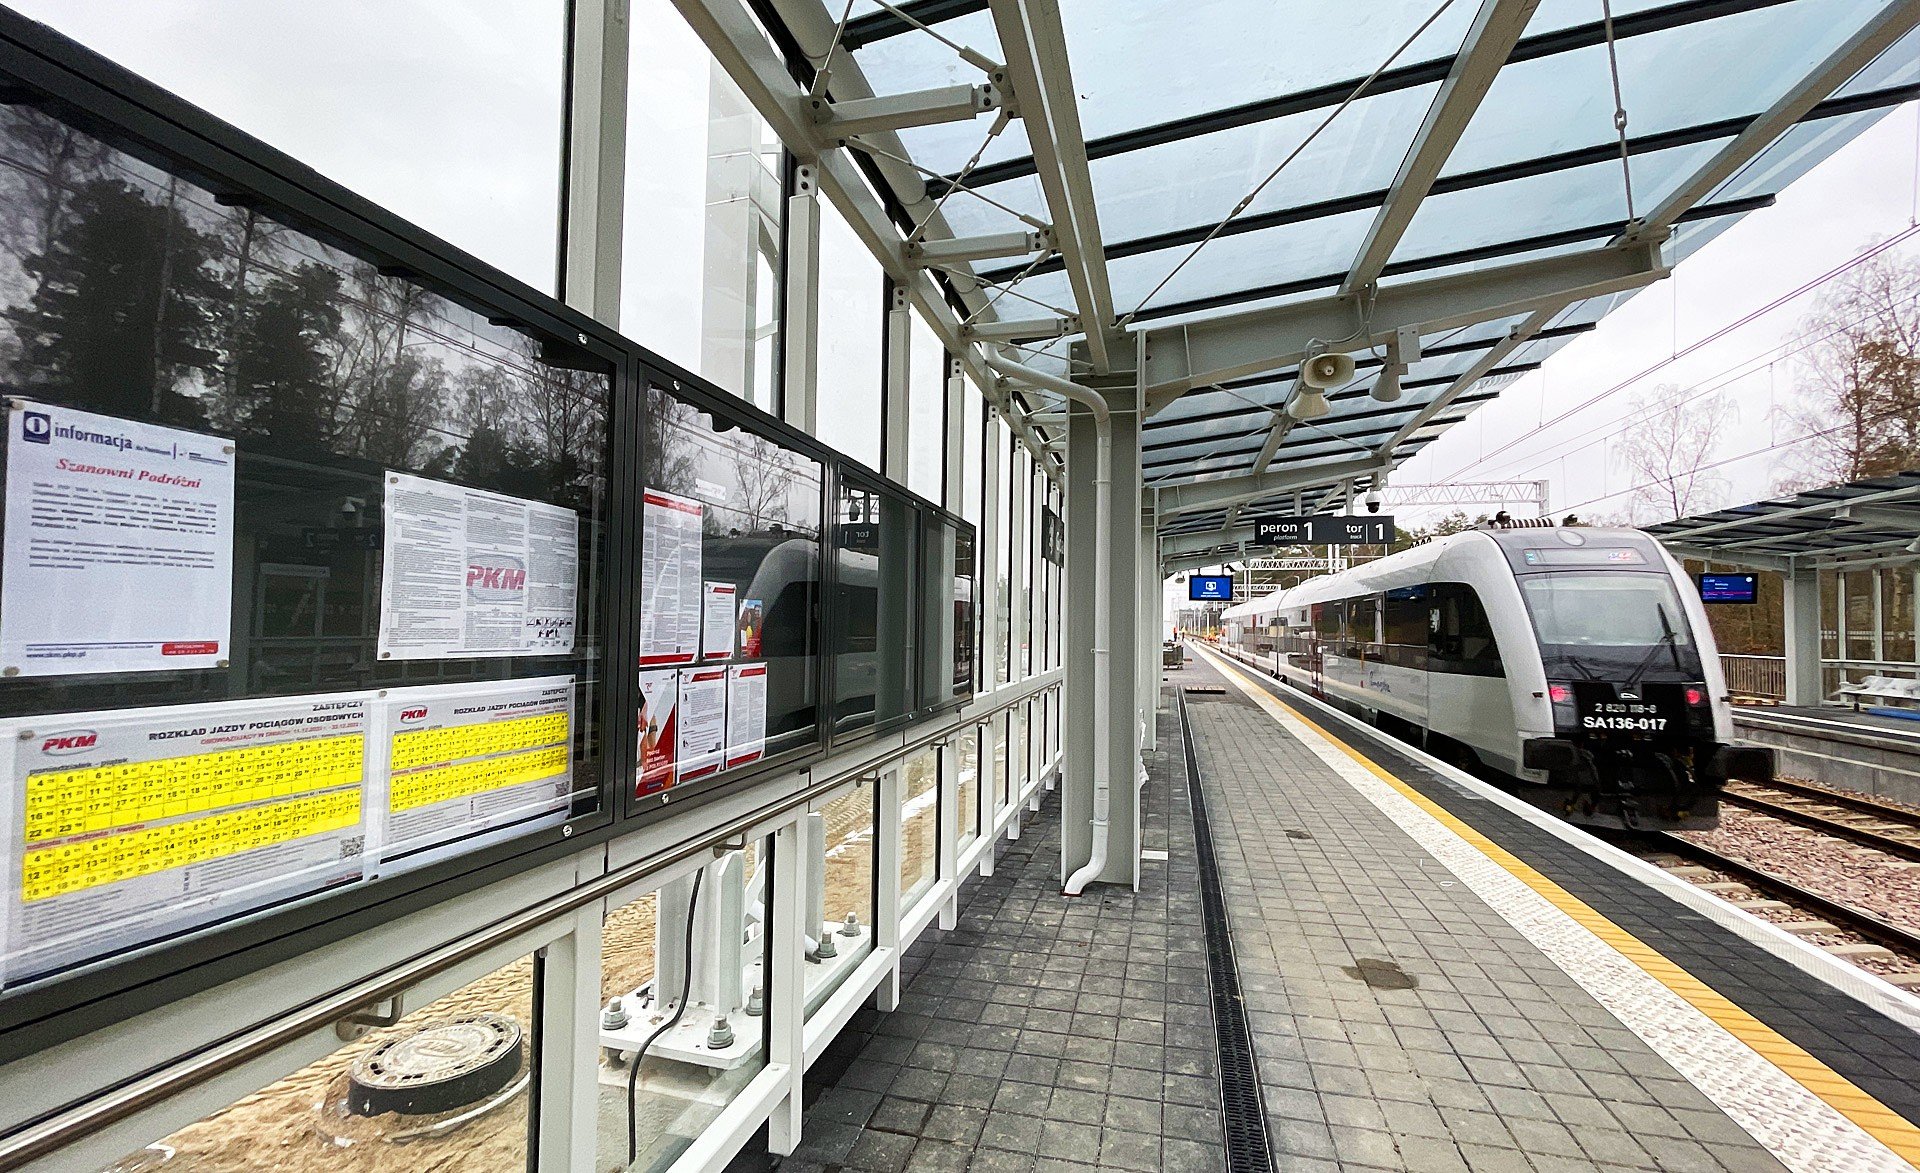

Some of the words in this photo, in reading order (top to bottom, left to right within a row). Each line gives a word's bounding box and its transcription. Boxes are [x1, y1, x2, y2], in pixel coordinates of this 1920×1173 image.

[54, 422, 133, 452] informacja
[55, 458, 135, 480] Szanowni
[138, 470, 202, 489] Podróżni
[1260, 523, 1298, 536] peron
[1303, 521, 1313, 541] 1
[1273, 534, 1298, 542] platform
[1345, 524, 1364, 533] tor
[1375, 523, 1384, 540] 1
[465, 564, 527, 591] PKM
[312, 700, 364, 712] ZASTĘPCZY
[399, 706, 428, 720] PKM
[453, 705, 486, 716] ROZKŁAD
[487, 703, 508, 712] JAZDY
[1594, 703, 1603, 712] 2
[148, 727, 207, 741] ROZKŁAD
[209, 722, 246, 735] JAZDY
[249, 717, 305, 731] POCIĄGÓW
[306, 711, 364, 725] OSOBOWYCH
[1583, 716, 1667, 731] SA136-017
[41, 733, 98, 752] PKM
